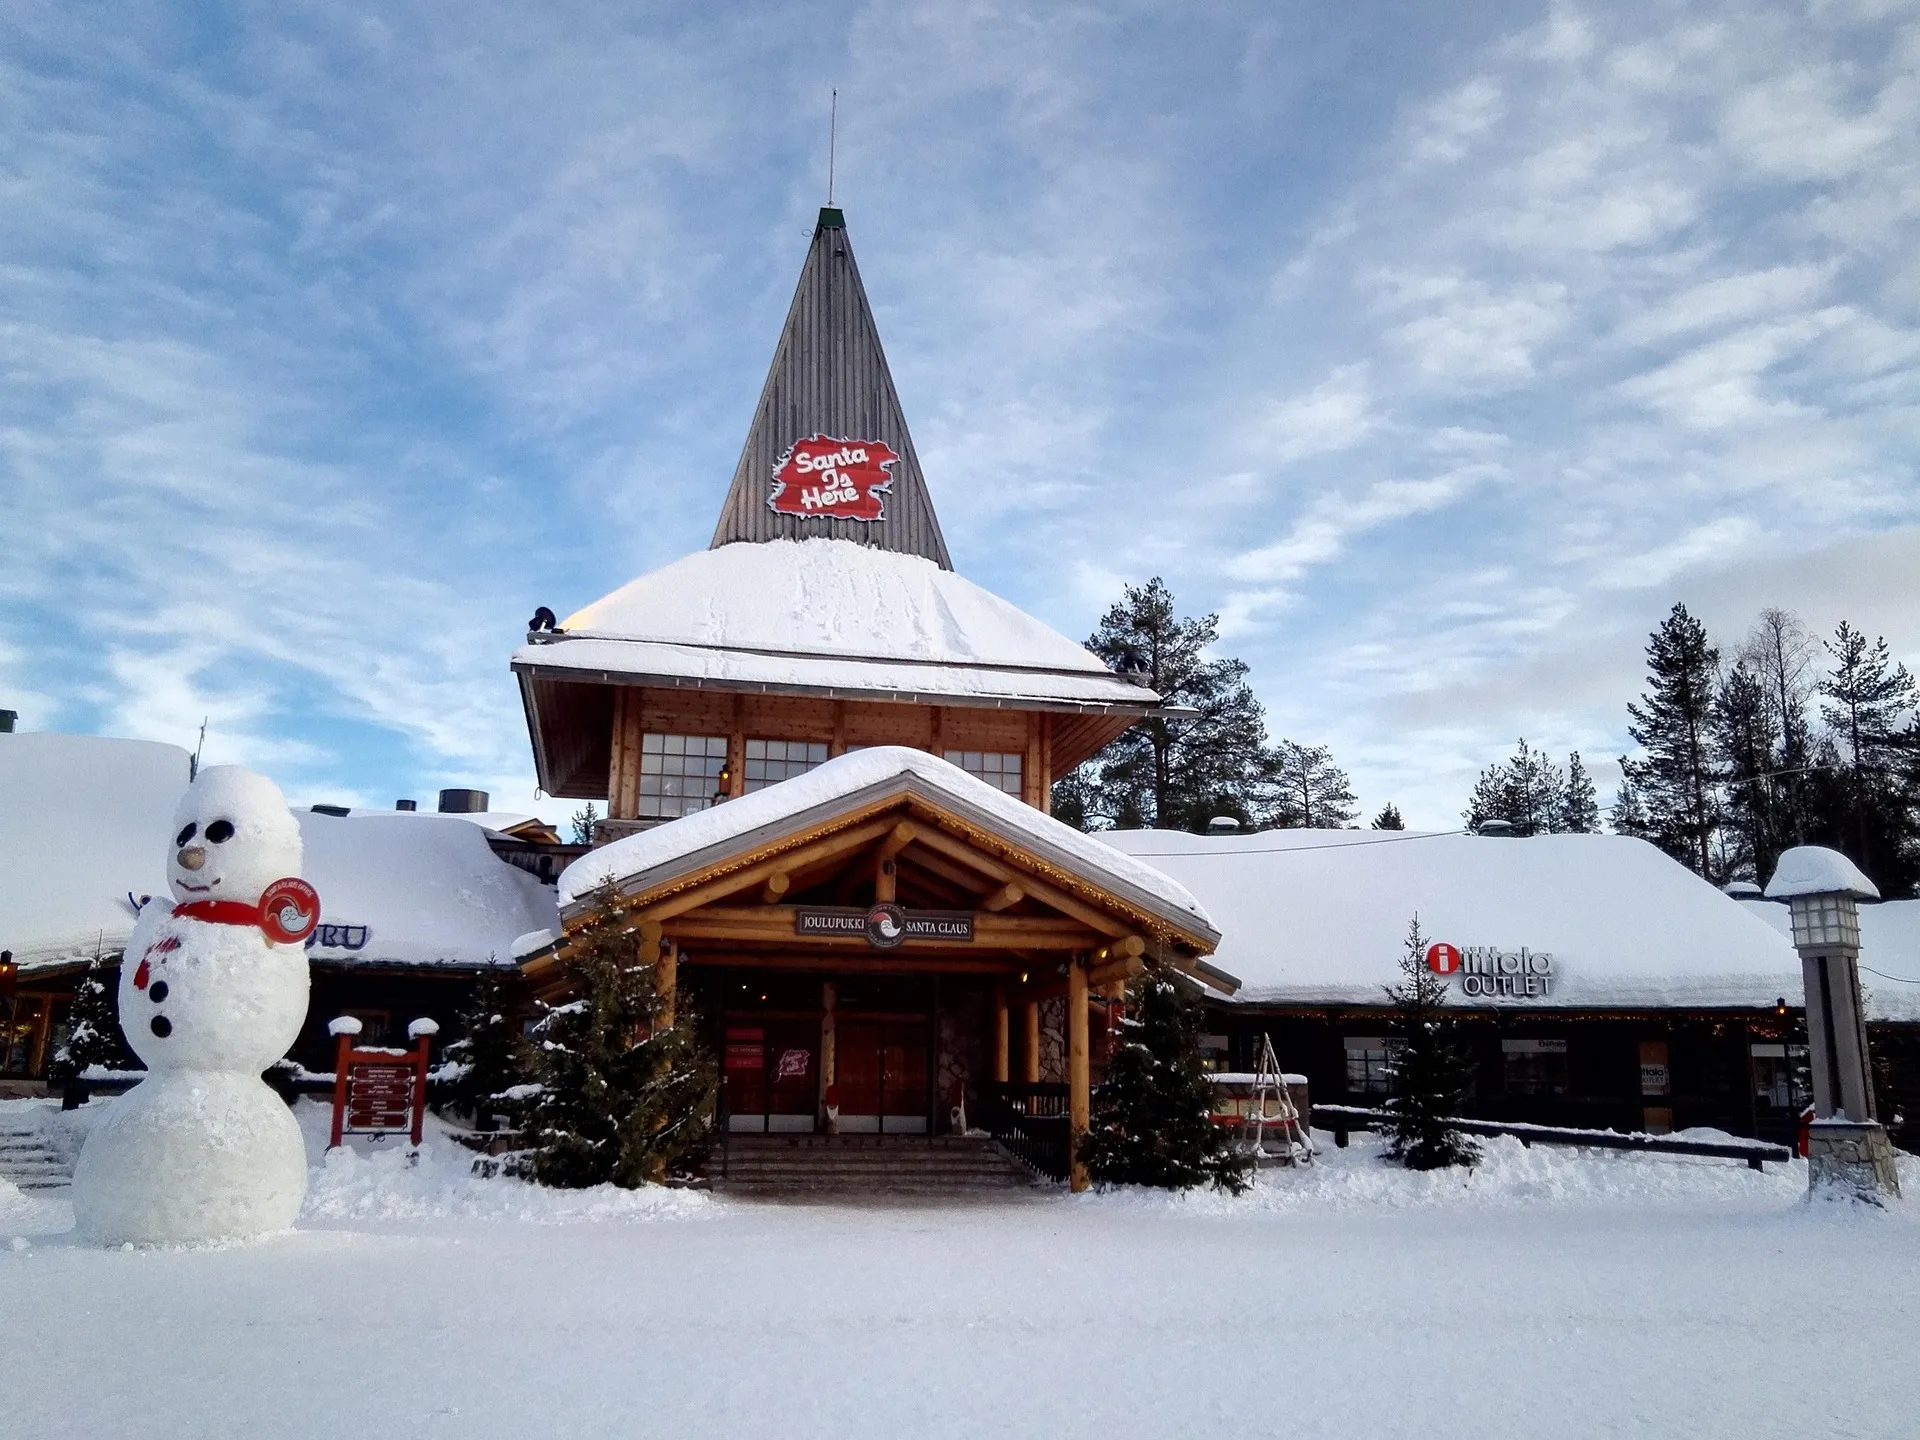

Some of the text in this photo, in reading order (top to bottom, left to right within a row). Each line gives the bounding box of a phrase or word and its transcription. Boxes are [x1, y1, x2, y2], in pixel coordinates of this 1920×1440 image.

[796, 446, 869, 474] Santa
[801, 486, 860, 510] Here
[803, 916, 865, 929] JOULUPUKKI
[905, 921, 968, 934] SANTA CLAUS
[1463, 975, 1553, 995] OUTLET
